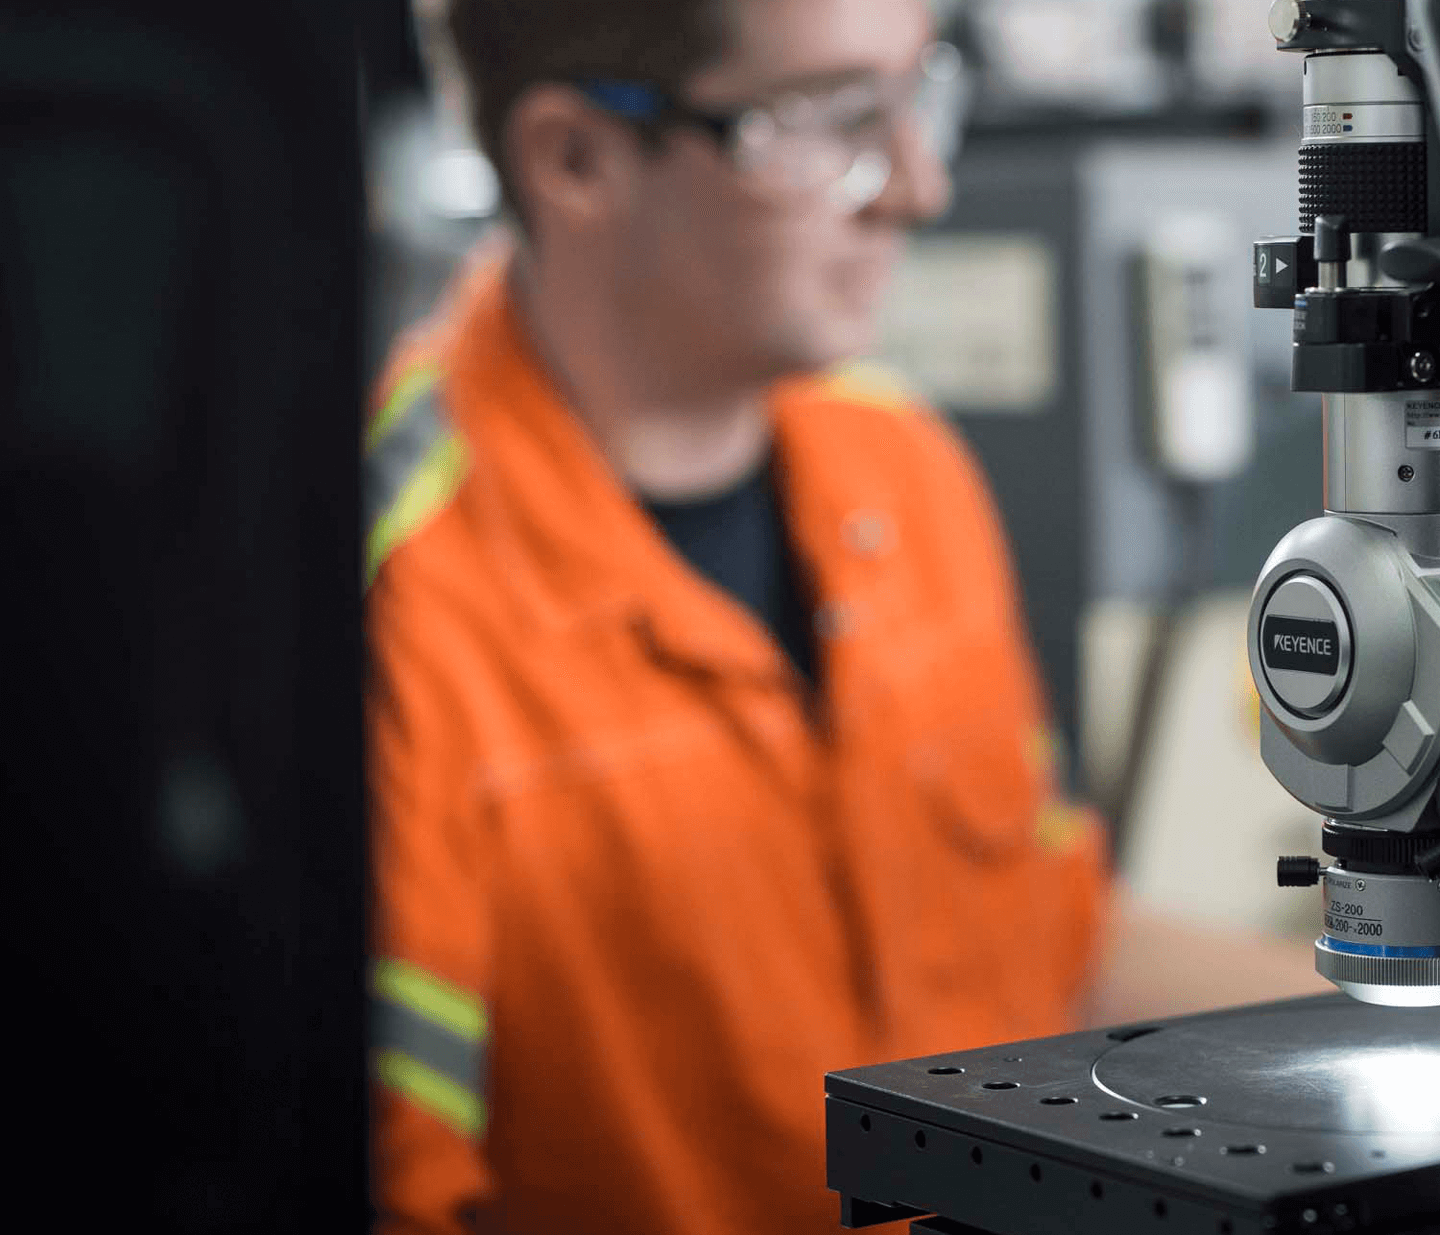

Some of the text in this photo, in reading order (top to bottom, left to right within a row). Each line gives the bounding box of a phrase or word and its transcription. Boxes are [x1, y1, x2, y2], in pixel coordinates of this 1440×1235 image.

[1322, 112, 1337, 122] 200
[1322, 123, 1342, 134] 2000
[1259, 252, 1267, 278] 2
[1273, 633, 1332, 656] KEYENCE
[1331, 900, 1364, 916] ZS-200
